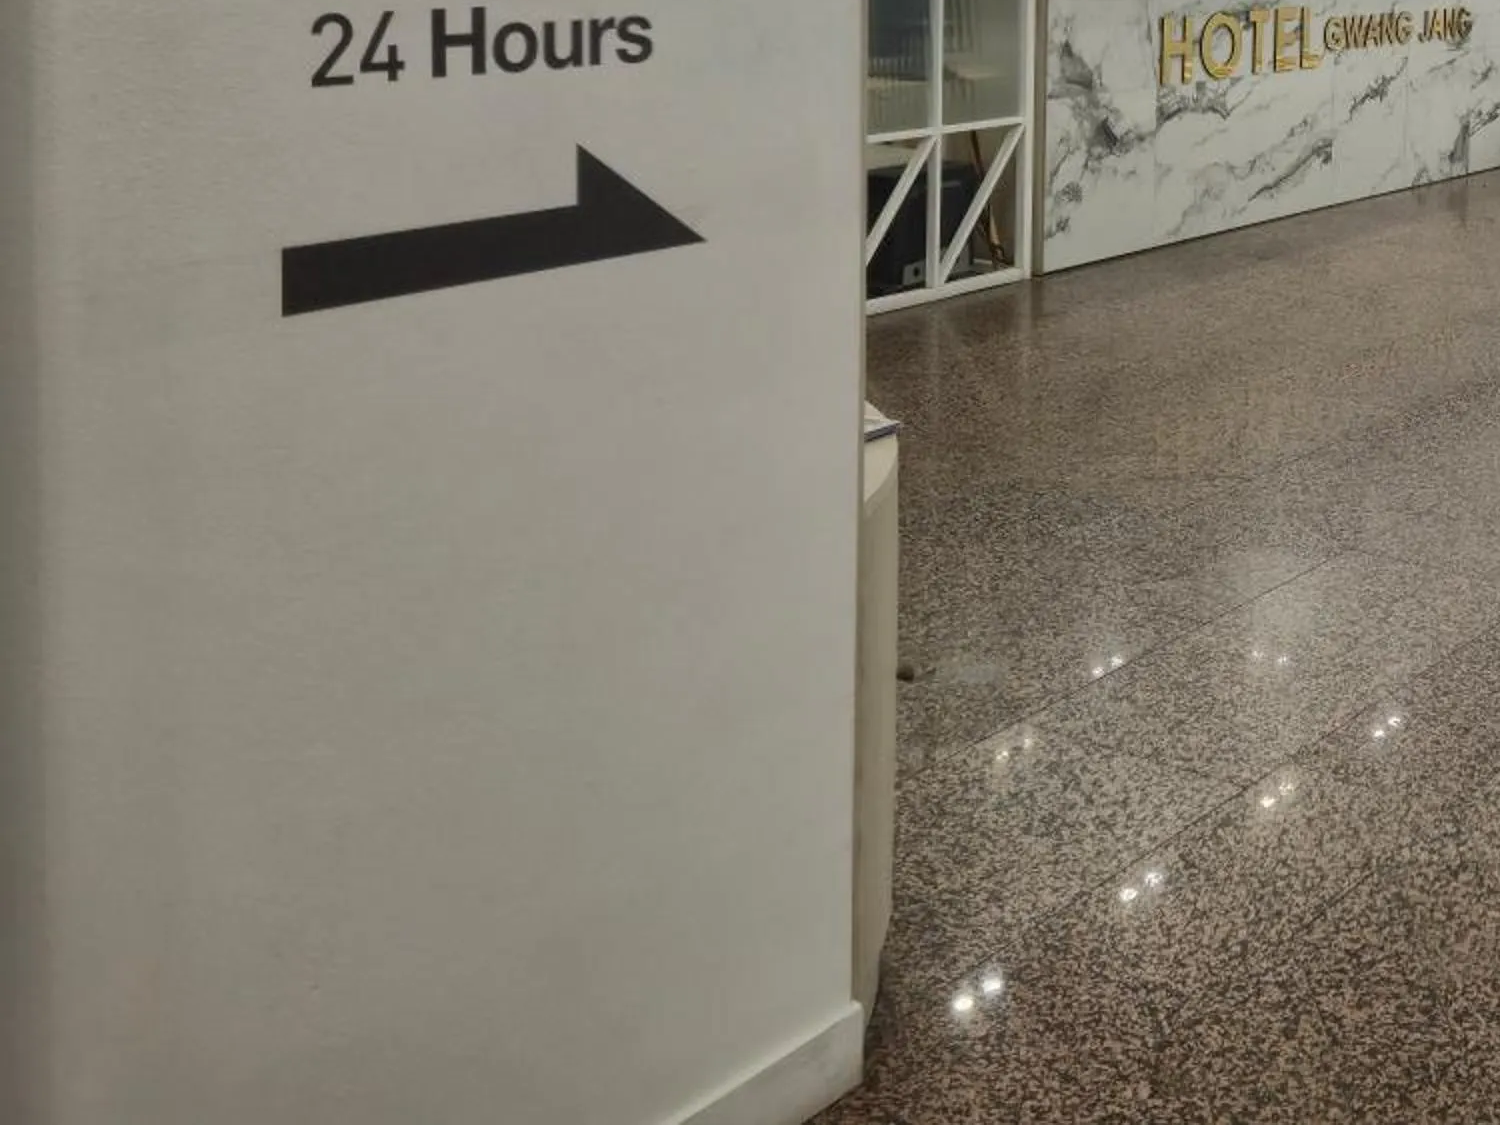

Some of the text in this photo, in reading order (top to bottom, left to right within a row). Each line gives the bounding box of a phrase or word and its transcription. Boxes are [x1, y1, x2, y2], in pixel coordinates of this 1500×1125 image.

[310, 6, 655, 88] 24 Hours
[1158, 5, 1474, 86] HOTEL GWANG JANG
